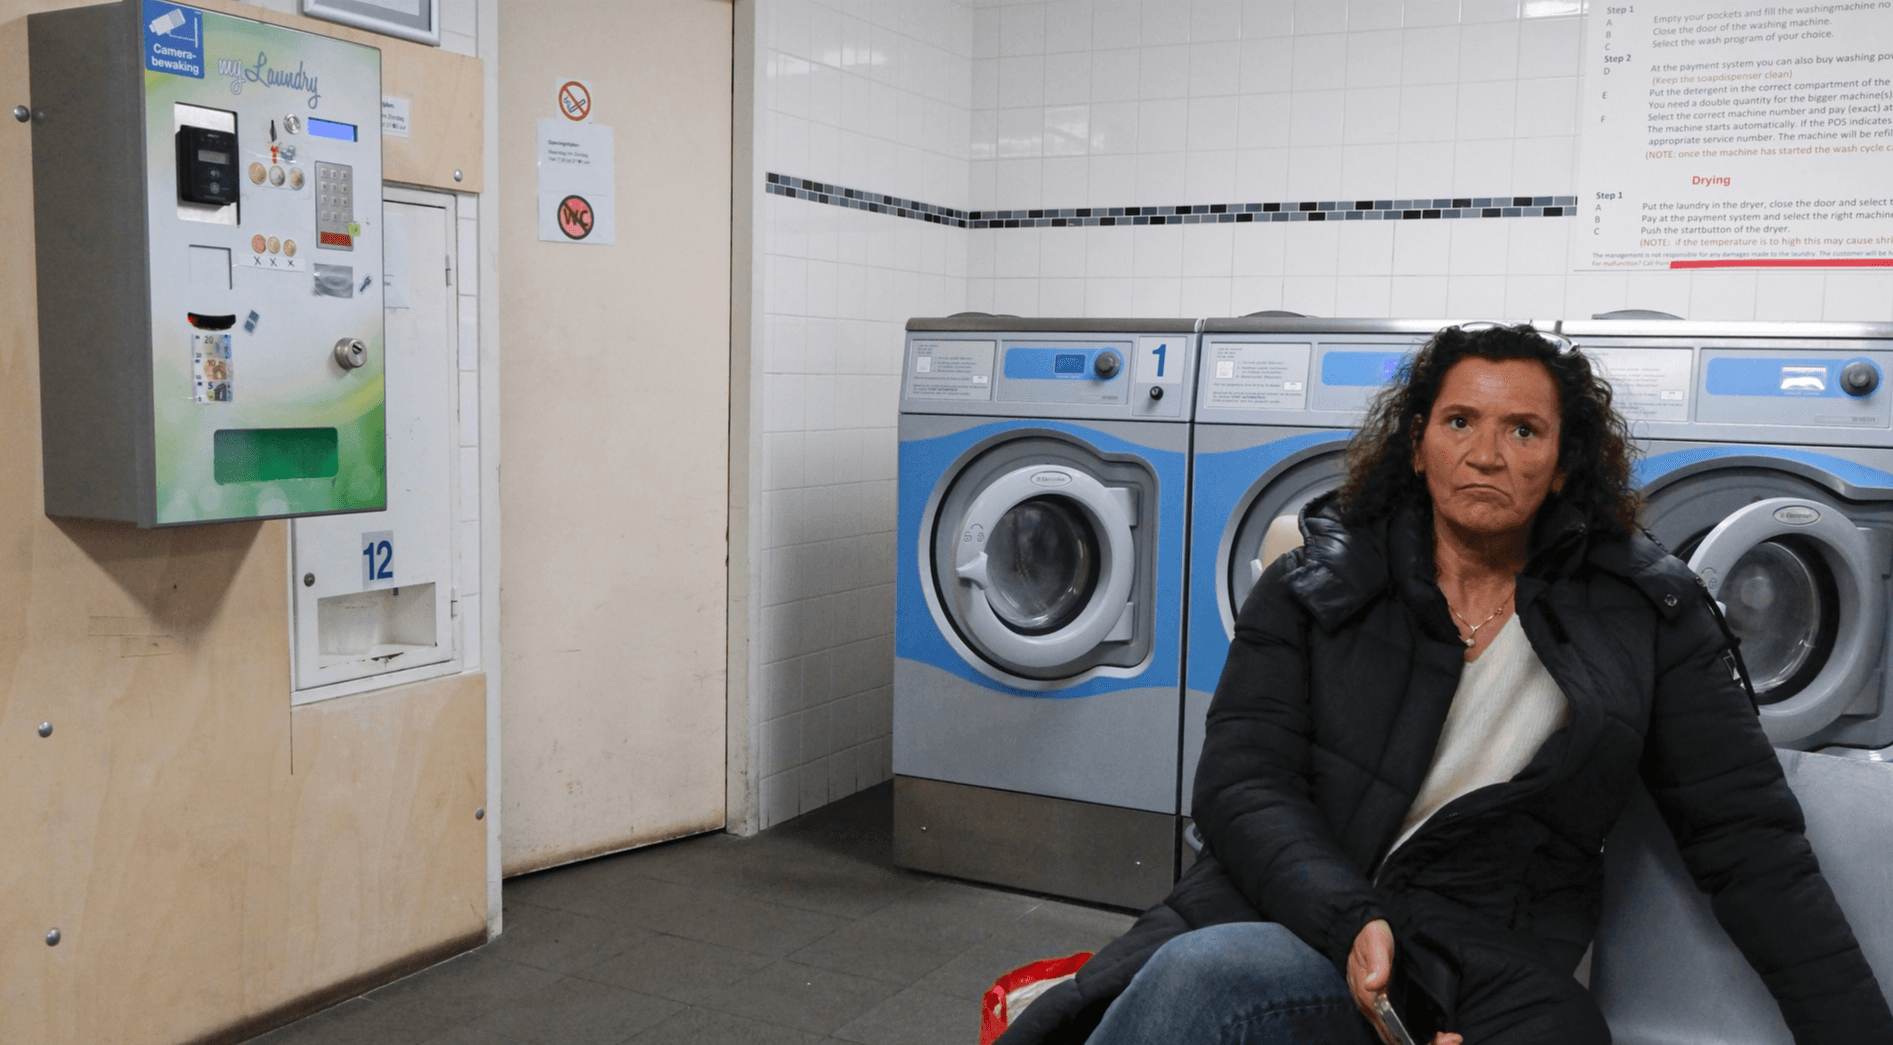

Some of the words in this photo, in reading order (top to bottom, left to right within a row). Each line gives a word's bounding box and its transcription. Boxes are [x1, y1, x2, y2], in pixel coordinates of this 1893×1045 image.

[1607, 6, 1626, 15] Step
[1654, 15, 1682, 24] Empty
[1684, 14, 1704, 23] your
[1707, 10, 1742, 21] pockets
[1744, 8, 1762, 17] and
[1764, 7, 1776, 16] fill
[1778, 7, 1794, 15] the
[1796, 2, 1876, 14] washingmachine
[1653, 27, 1677, 36] Close
[1679, 26, 1694, 34] the
[1696, 24, 1718, 33] door
[1720, 22, 1730, 32] of
[1732, 23, 1747, 31] the
[1749, 20, 1787, 30] washing
[1789, 18, 1832, 27] machine.
[1652, 40, 1678, 48] Select
[1681, 38, 1696, 46] the
[1698, 36, 1722, 45] wash
[1724, 35, 1763, 45] program
[1765, 32, 1776, 41] of
[1778, 33, 1799, 42] your
[1801, 30, 1834, 39] choice.
[153, 43, 197, 60] Camera-
[1604, 55, 1623, 63] Step
[151, 57, 200, 76] bewaking
[1663, 64, 1678, 72] the
[1680, 62, 1719, 72] payment
[1722, 60, 1754, 70] system
[1756, 60, 1774, 68] you
[1794, 56, 1814, 65] also
[1816, 55, 1834, 64] buy
[1836, 53, 1875, 63] washing
[1652, 77, 1678, 86] (Keep
[1697, 73, 1762, 83] soapdispenser
[1764, 70, 1792, 79] clean)
[1683, 86, 1727, 96] detergent
[1741, 84, 1756, 92] the
[1758, 83, 1792, 92] correct
[1794, 80, 1859, 90] compartment
[1861, 78, 1872, 87] of
[1874, 78, 1890, 86] the
[1667, 100, 1690, 108] need
[1699, 98, 1731, 107] double
[1733, 97, 1772, 106] quantity
[1774, 95, 1787, 103] for
[1790, 95, 1805, 103] the
[1808, 94, 1837, 104] bigger
[1648, 113, 1674, 121] Select
[1676, 112, 1691, 120] the
[1693, 111, 1725, 119] correct
[1728, 109, 1767, 118] machine
[1769, 107, 1806, 116] number
[1808, 106, 1826, 114] and
[1828, 107, 1846, 115] pay
[1848, 103, 1881, 114] (exact)
[1665, 124, 1703, 132] machine
[1733, 120, 1797, 130] automatically.
[1800, 119, 1807, 127] If
[1809, 119, 1825, 127] the
[1828, 118, 1847, 126] POS
[1849, 117, 1892, 125] indicates
[1648, 137, 1701, 146] appropriate
[1736, 134, 1775, 142] number.
[1798, 131, 1838, 140] machine
[1840, 130, 1857, 138] will
[1859, 130, 1871, 138] be
[1692, 176, 1731, 186] Drying
[1676, 202, 1710, 210] laundry
[1740, 201, 1767, 210] dryer,
[1769, 200, 1793, 208] close
[1796, 199, 1812, 207] the
[1813, 199, 1836, 207] door
[1838, 198, 1857, 207] and
[1859, 198, 1887, 206] select
[563, 208, 589, 227] WC
[1642, 215, 1657, 224] Pay
[1687, 214, 1726, 223] payment
[1729, 214, 1761, 222] system
[1763, 212, 1781, 221] and
[1783, 212, 1810, 220] select
[1831, 211, 1853, 221] right
[1641, 226, 1662, 234] Push
[1681, 226, 1732, 234] startbutton
[1734, 225, 1744, 233] of
[1763, 225, 1790, 234] dryer.
[1700, 238, 1758, 247] temperature
[1782, 237, 1801, 247] high
[1804, 237, 1821, 245] this
[204, 336, 213, 344] 20
[1152, 344, 1166, 377] 1
[363, 539, 393, 581] 12
